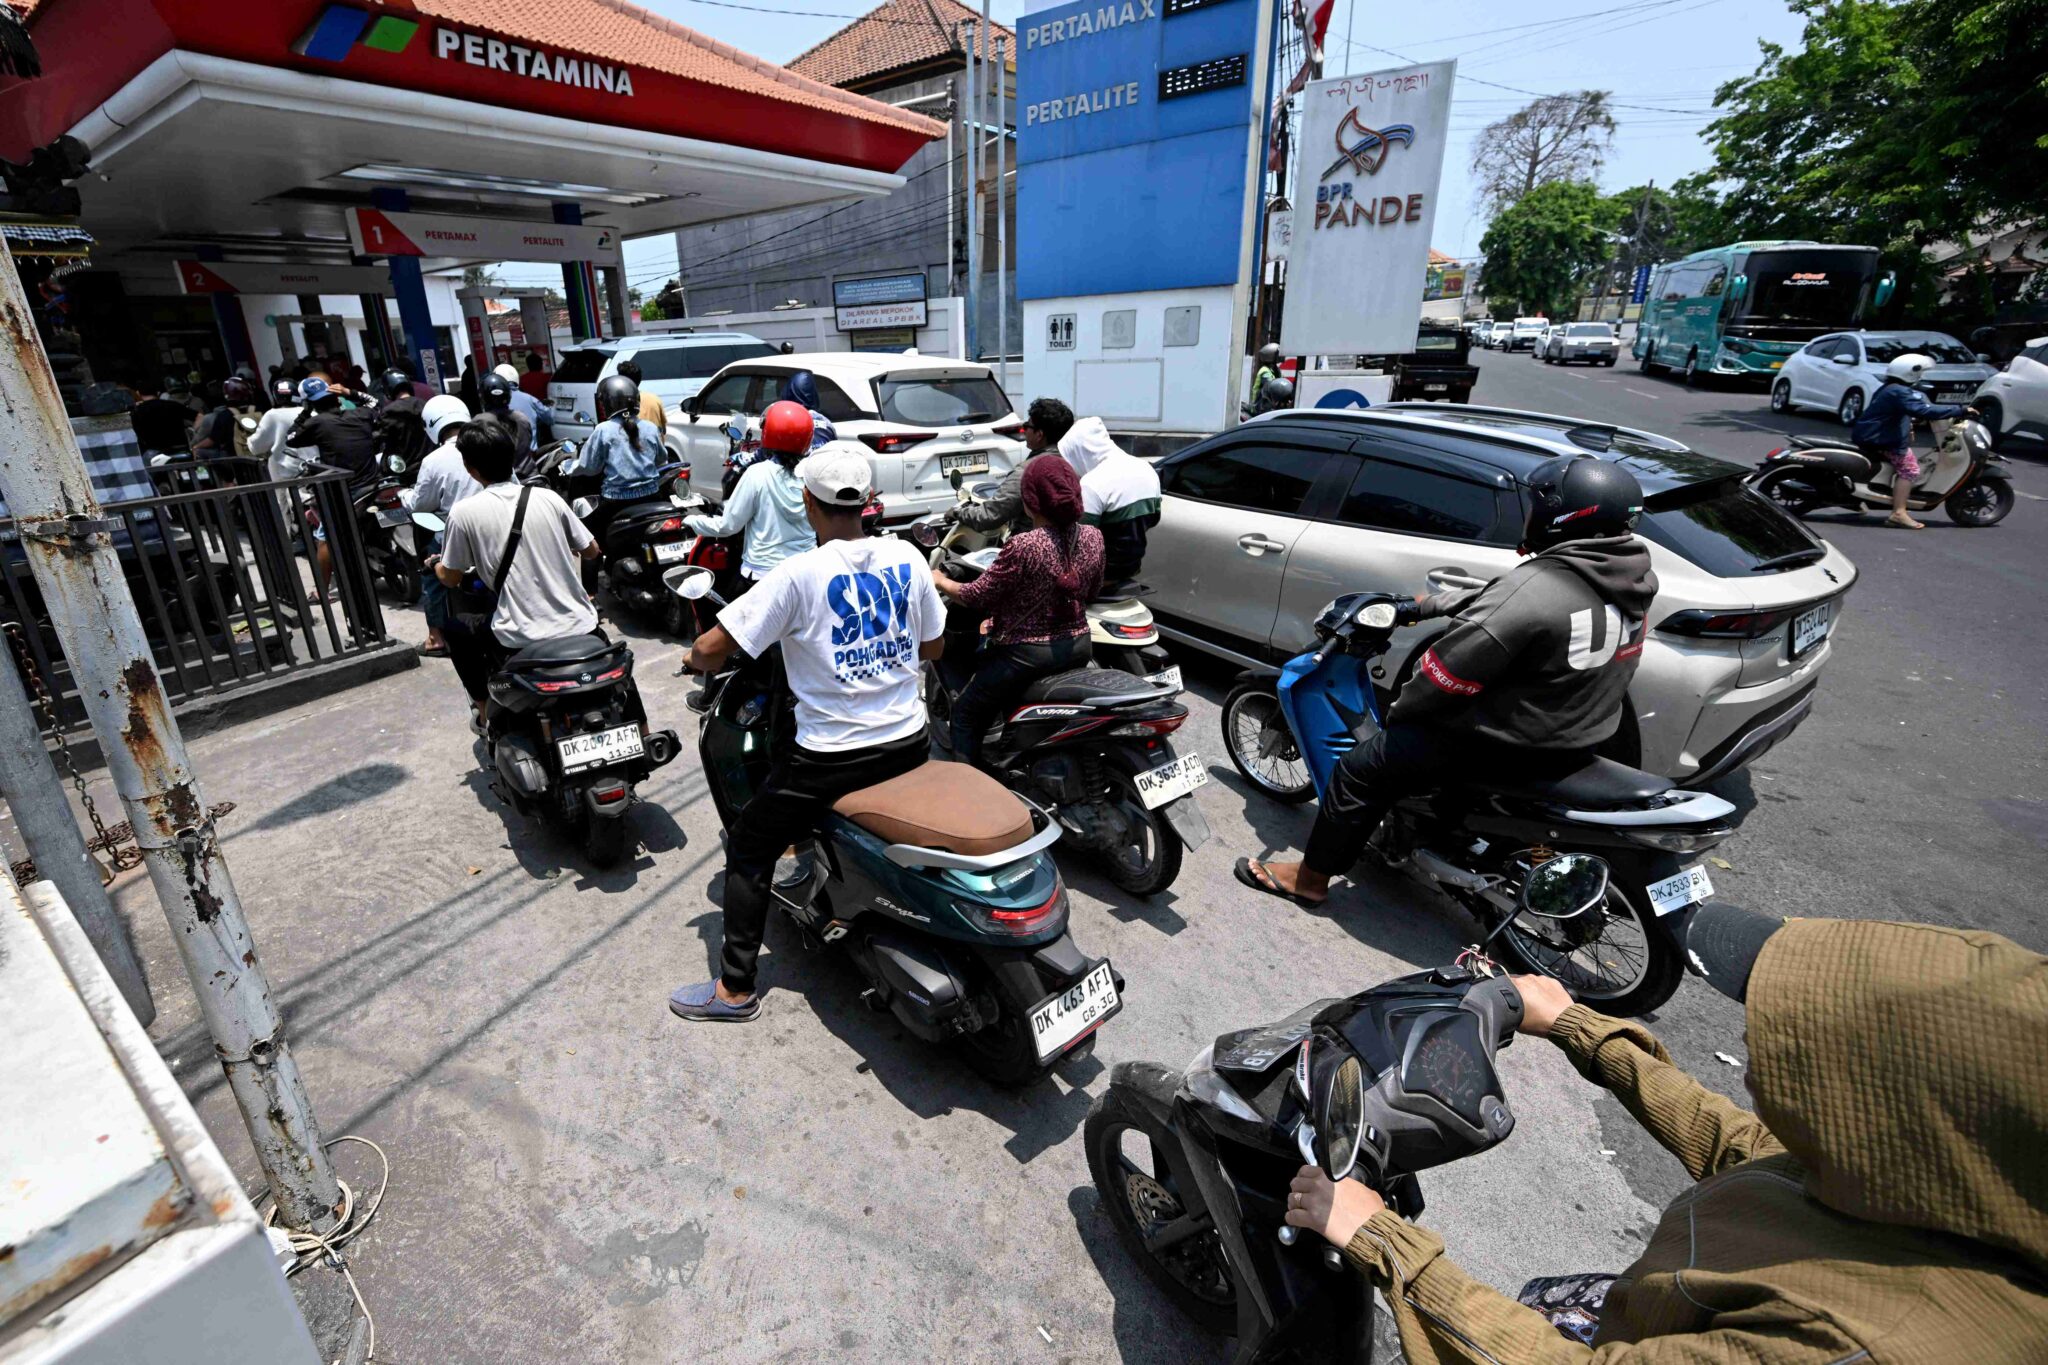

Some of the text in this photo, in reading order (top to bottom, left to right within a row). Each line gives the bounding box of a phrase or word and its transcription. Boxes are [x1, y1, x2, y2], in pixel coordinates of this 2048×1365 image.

[1026, 0, 1156, 50] PERTAMAX
[437, 27, 634, 97] PERTAMINA
[1026, 81, 1139, 127] PERTALITE
[1316, 182, 1354, 203] BPR
[1313, 193, 1424, 230] PANDE
[372, 225, 384, 245] 1
[425, 229, 478, 243] PERTAMAX
[522, 235, 566, 248] PERTALITE
[192, 272, 205, 286] 2
[846, 306, 914, 318] DILARANG MEROKOK
[1049, 340, 1073, 348] TOILET
[943, 456, 954, 469] DK
[955, 455, 973, 468] 1775
[827, 563, 911, 646] SDY
[1428, 661, 1454, 688] POKER
[563, 726, 640, 757] DK 2092 AFM
[570, 764, 588, 774] YAMAHA
[1138, 774, 1157, 792] DK
[1155, 762, 1182, 784] 3639
[1008, 867, 1034, 884] HONDA
[1650, 869, 1706, 902] DK 7533 BV
[1034, 967, 1110, 1035] DK 4463 AFI
